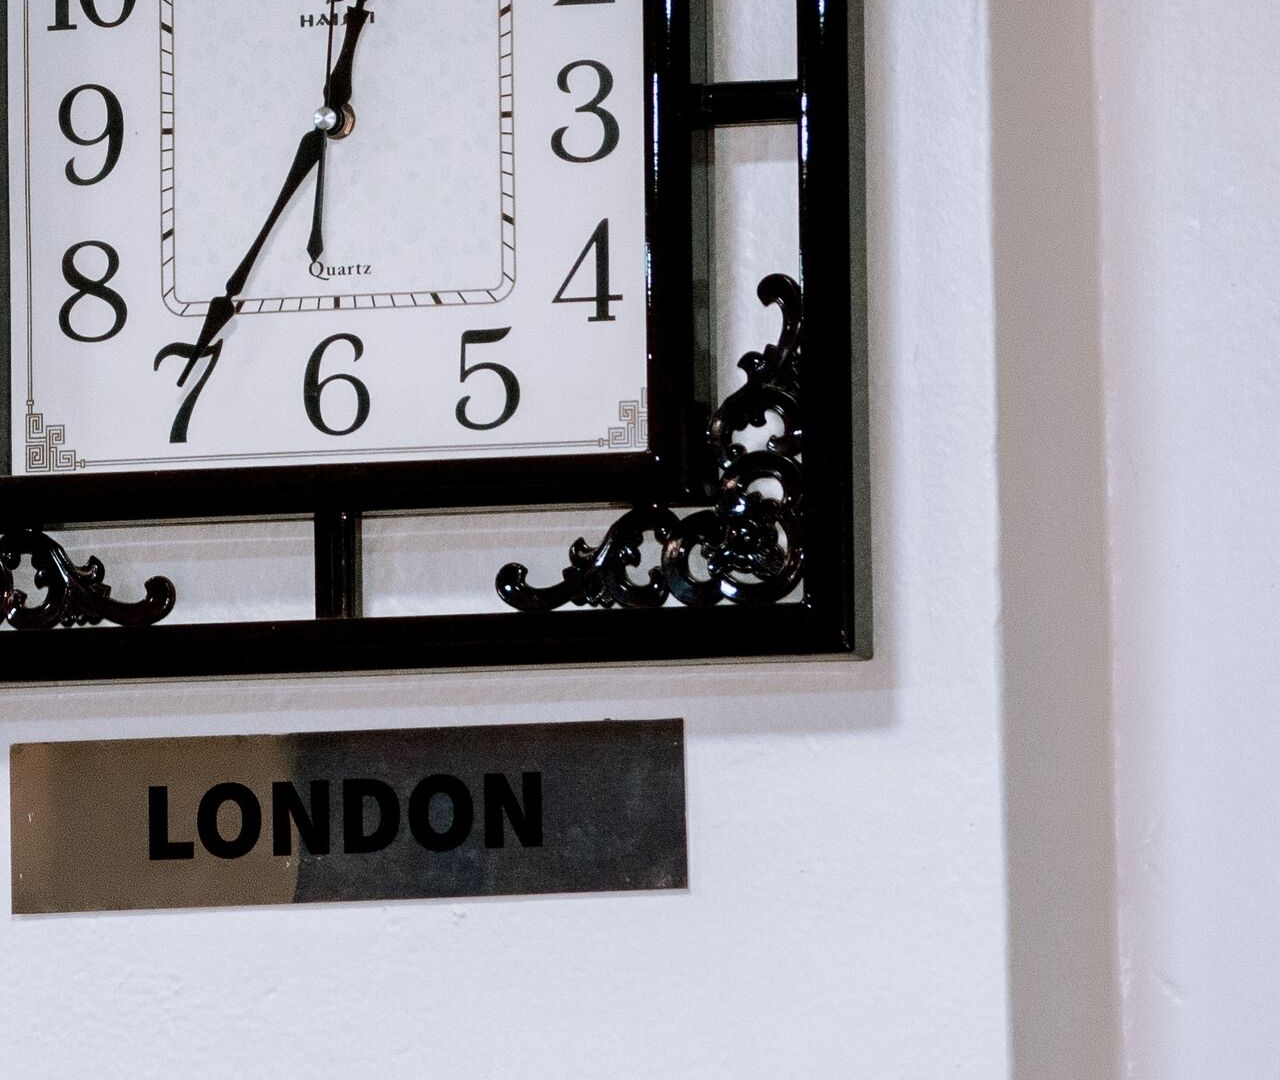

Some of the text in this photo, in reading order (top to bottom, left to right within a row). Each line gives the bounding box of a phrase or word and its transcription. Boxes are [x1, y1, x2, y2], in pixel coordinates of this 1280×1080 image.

[59, 84, 123, 185] 9
[551, 60, 619, 163] 3
[59, 241, 127, 342] 8
[308, 261, 372, 280] Quartz
[553, 219, 622, 321] 4
[154, 337, 223, 443] 7
[304, 333, 370, 435] 6
[456, 327, 520, 430] 5
[146, 769, 543, 863] LONDON
